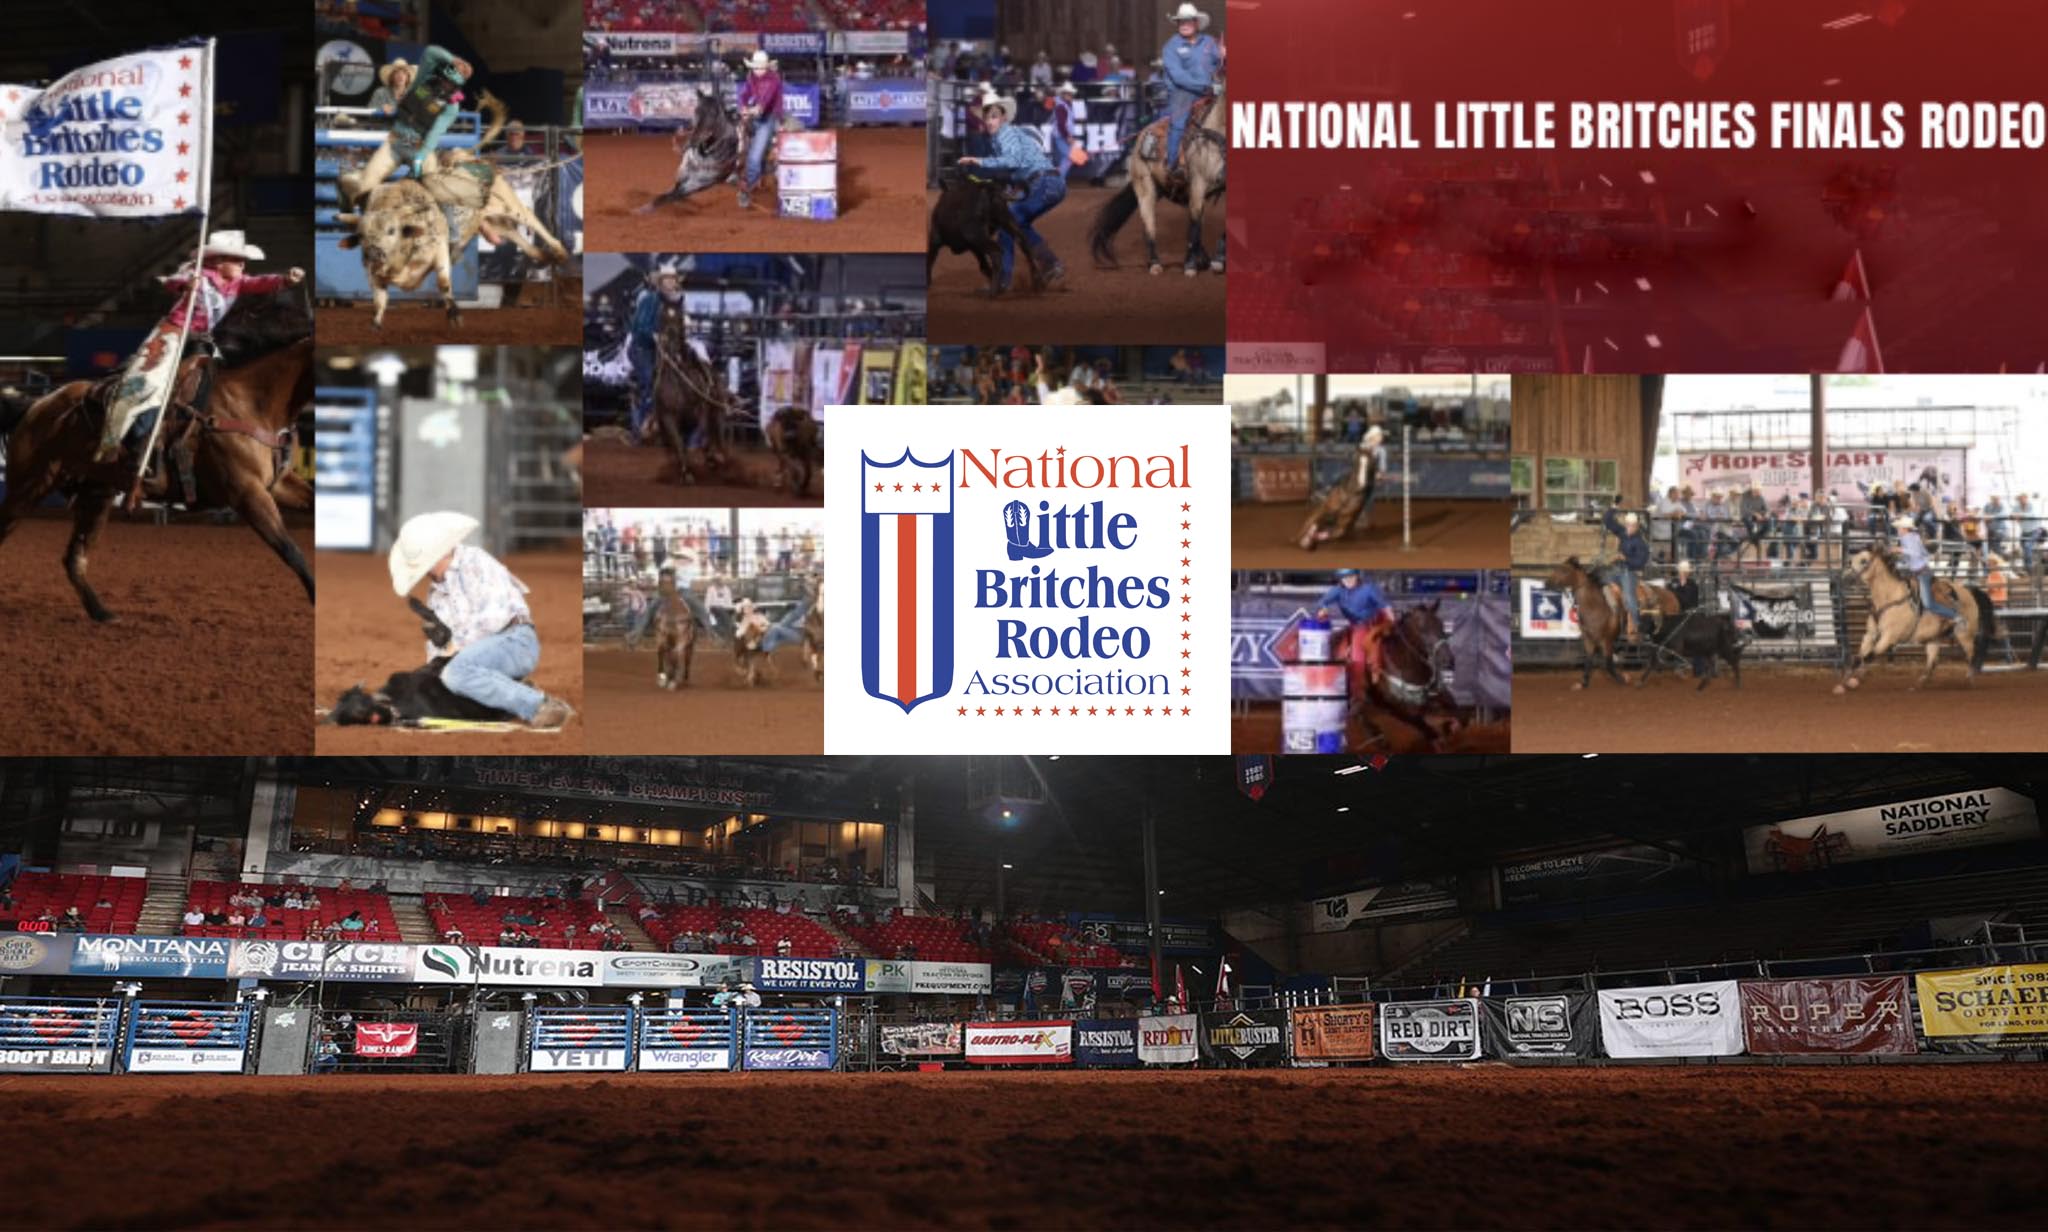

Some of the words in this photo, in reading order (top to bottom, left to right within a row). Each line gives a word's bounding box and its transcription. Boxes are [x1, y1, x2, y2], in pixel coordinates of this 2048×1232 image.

[40, 157, 145, 190] Rodeo
[1881, 794, 1991, 822] NATIONAL
[1885, 809, 1991, 836] SADDLERY
[78, 937, 225, 955] MONTANA
[282, 942, 409, 963] CINCH
[349, 964, 406, 974] SHIRTS
[469, 954, 594, 978] Nutrena
[762, 959, 859, 981] RESISTOL
[778, 980, 798, 988] LIVE
[800, 980, 807, 988] IT
[838, 981, 857, 989] DAY
[1975, 975, 2015, 986] SINCE
[1614, 991, 1721, 1020] BOSS
[1750, 1001, 1903, 1021] ROPER
[1391, 1022, 1422, 1038] RED
[1430, 1020, 1471, 1037] DIRT
[971, 1030, 1056, 1050] GASTRO-PLEX
[1079, 1030, 1134, 1047] RESISTOL
[1143, 1031, 1169, 1046] RFD
[51, 1050, 107, 1065] BARN
[548, 1050, 608, 1066] YETI
[653, 1051, 718, 1067] Wrangler
[746, 1049, 783, 1064] Red
[784, 1049, 824, 1063] Dirt
